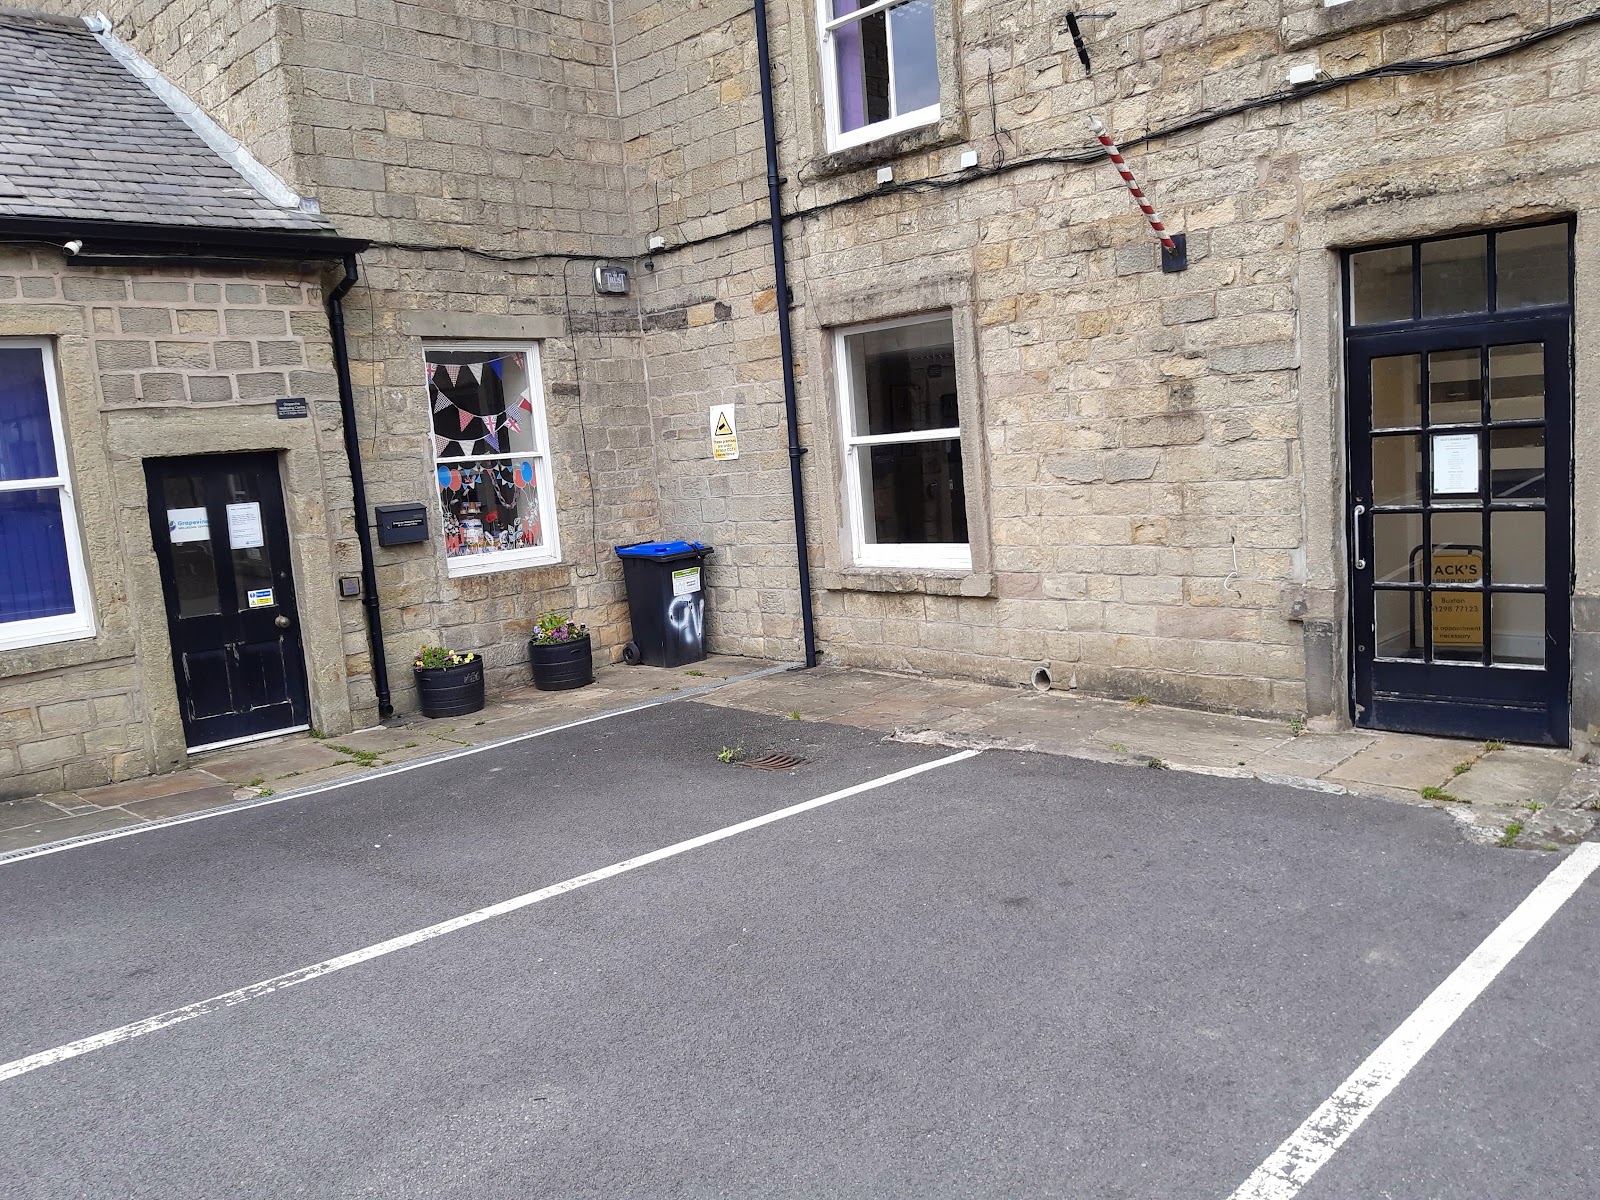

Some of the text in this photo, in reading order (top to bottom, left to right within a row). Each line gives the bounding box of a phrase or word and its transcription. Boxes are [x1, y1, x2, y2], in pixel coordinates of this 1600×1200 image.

[1434, 564, 1478, 576] ACK'S
[1432, 605, 1479, 613] 1298 77123
